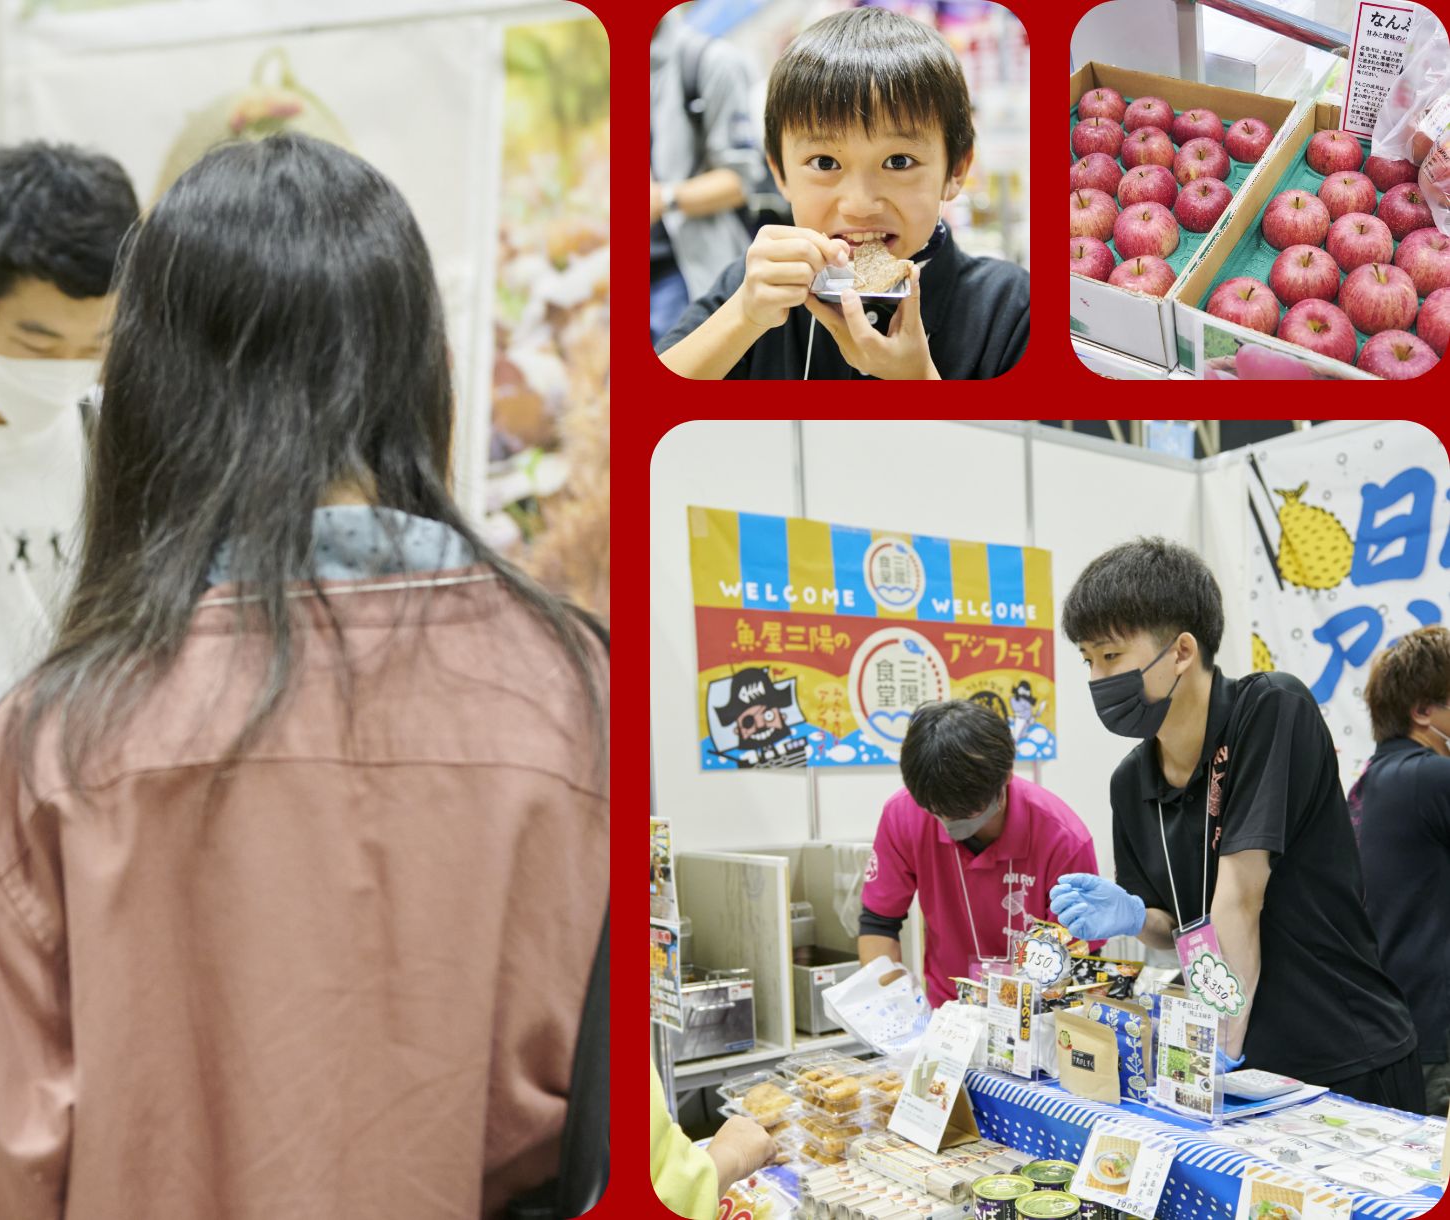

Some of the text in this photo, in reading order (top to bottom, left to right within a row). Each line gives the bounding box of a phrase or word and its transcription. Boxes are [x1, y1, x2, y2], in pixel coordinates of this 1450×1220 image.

[718, 580, 856, 608] WELCOME
[931, 598, 1037, 621] WELCOME
[731, 618, 852, 656] 魚屋三陽の
[943, 632, 1044, 668] アジフライ
[876, 659, 896, 708] 食堂
